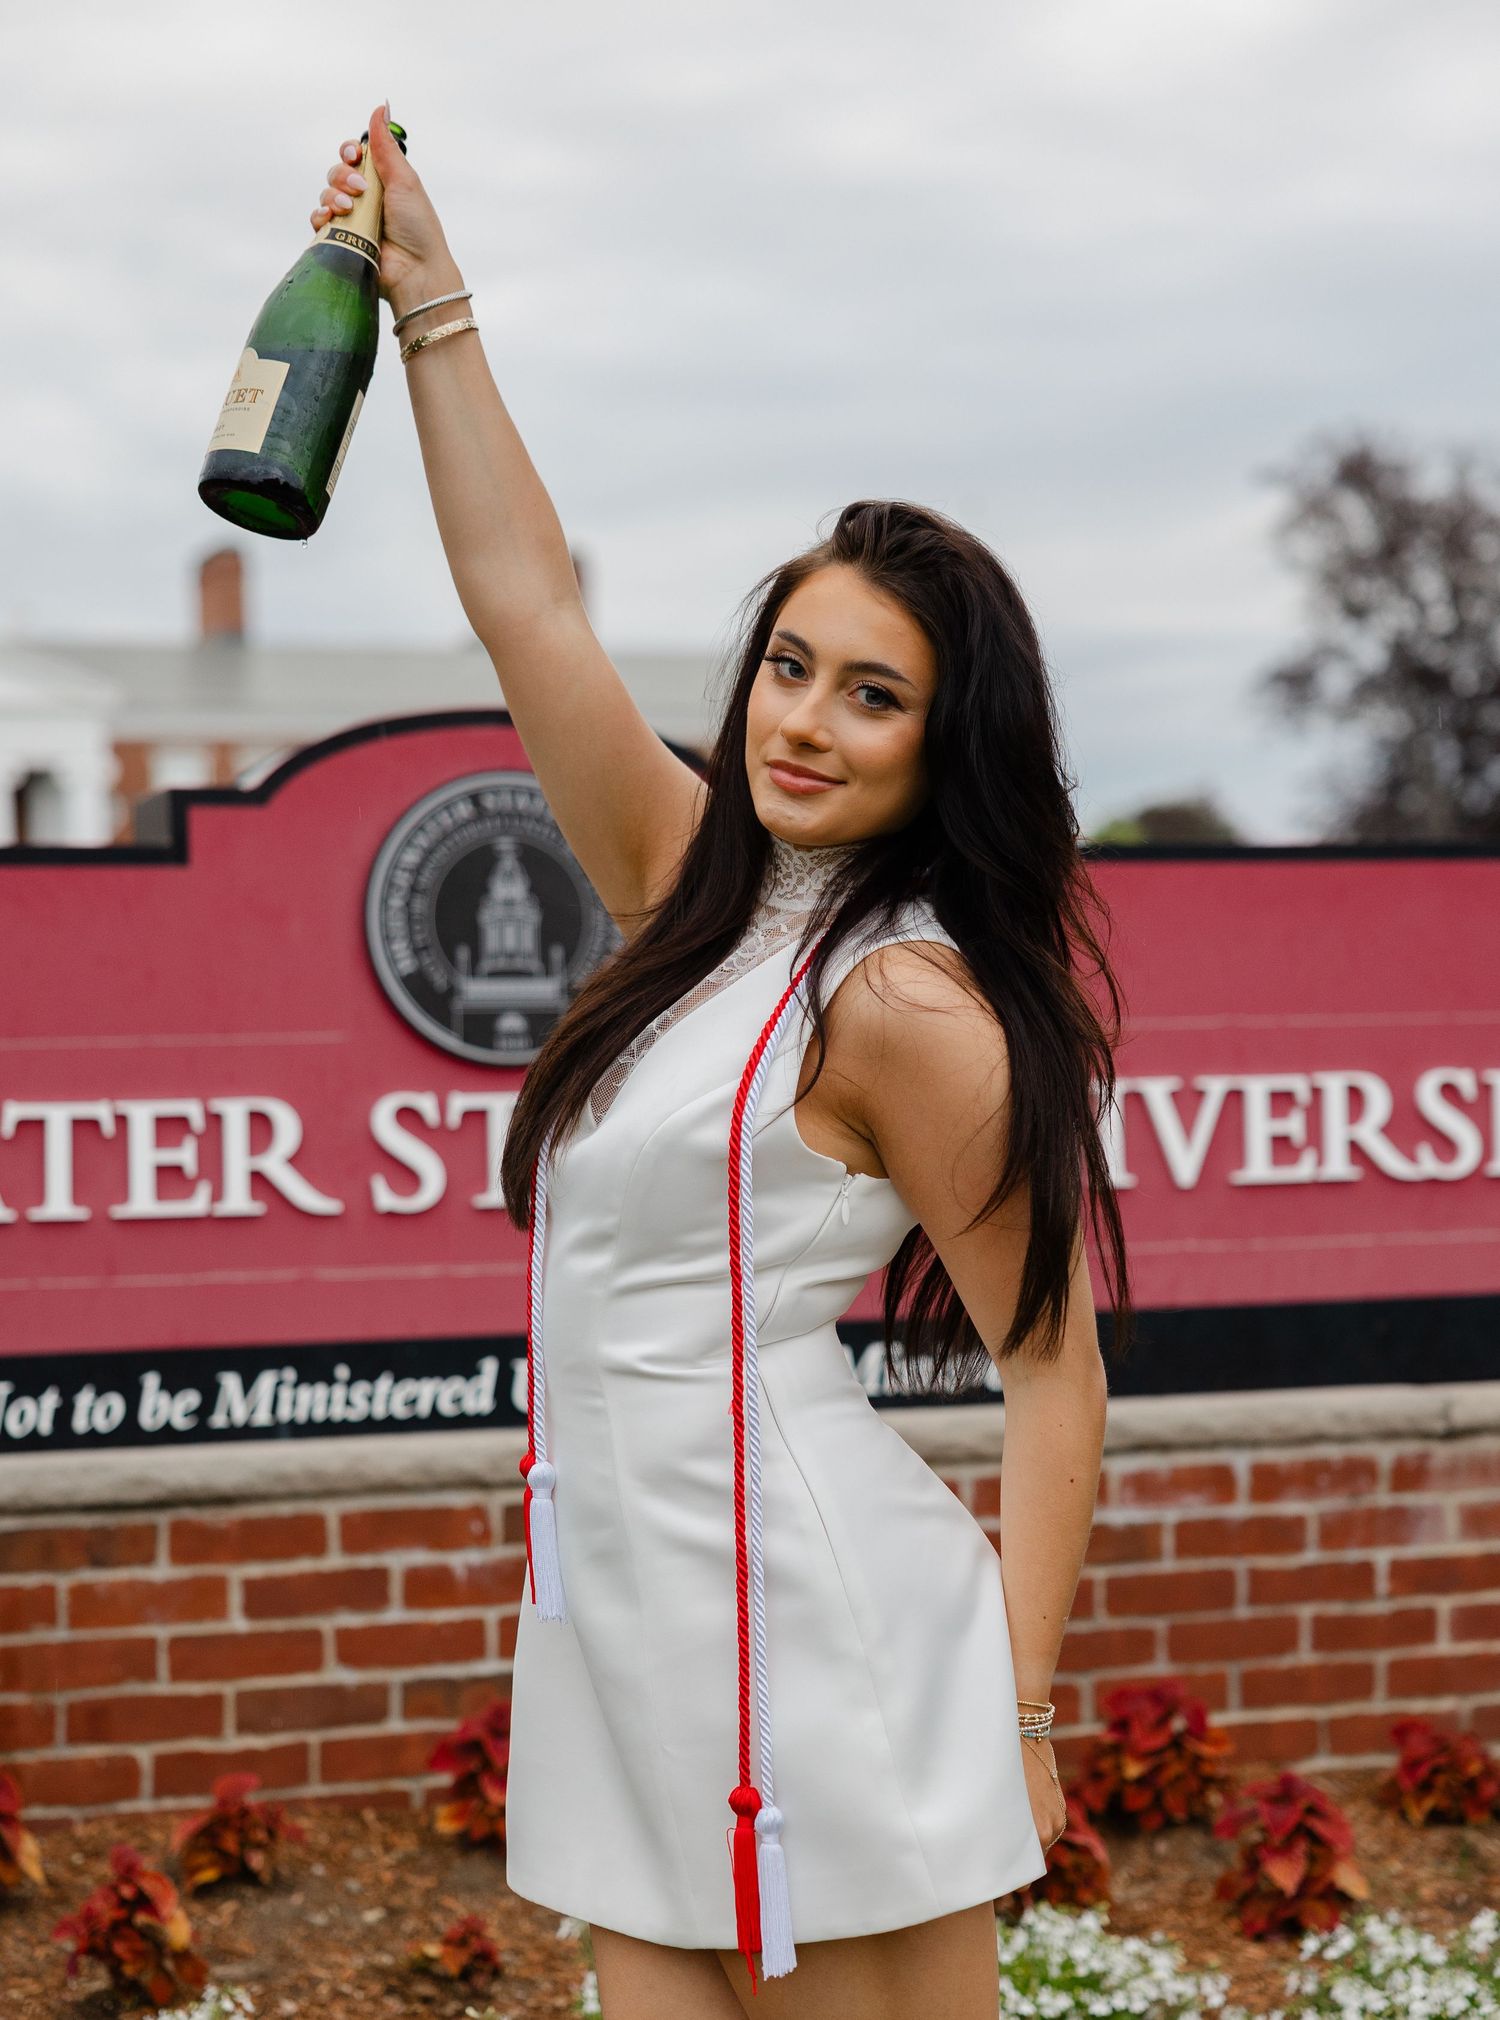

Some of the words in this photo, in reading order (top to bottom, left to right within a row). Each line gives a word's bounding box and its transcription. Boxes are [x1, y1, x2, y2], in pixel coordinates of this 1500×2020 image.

[0, 1096, 345, 1223] TER
[0, 1380, 63, 1439] ot
[71, 1383, 127, 1434] to
[138, 1370, 201, 1432] be
[206, 1355, 498, 1429] Ministered
